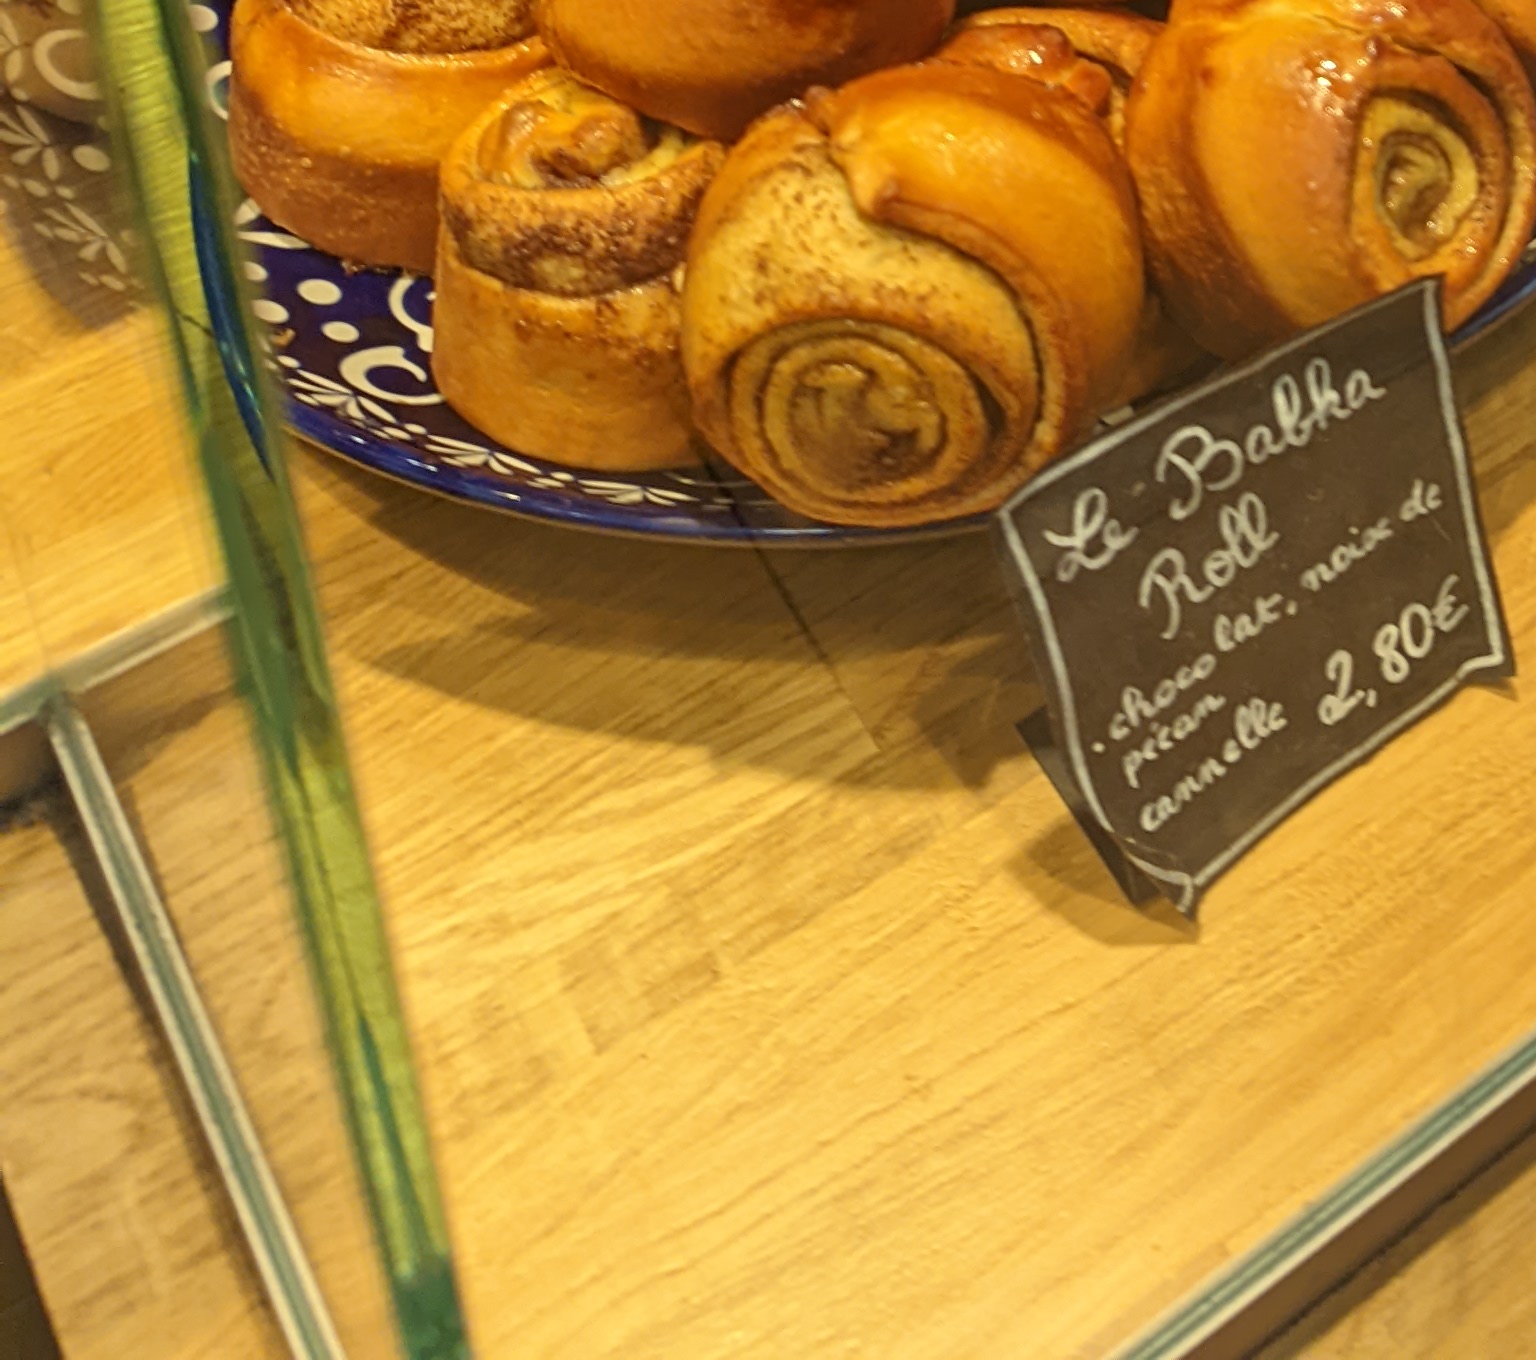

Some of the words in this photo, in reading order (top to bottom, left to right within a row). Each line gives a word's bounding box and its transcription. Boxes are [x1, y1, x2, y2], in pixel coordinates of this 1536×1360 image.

[1043, 487, 1138, 582] Le
[1155, 356, 1387, 521] Babka
[1399, 478, 1442, 522] de
[1139, 492, 1279, 640] Roll
[1140, 696, 1288, 832] cannelle
